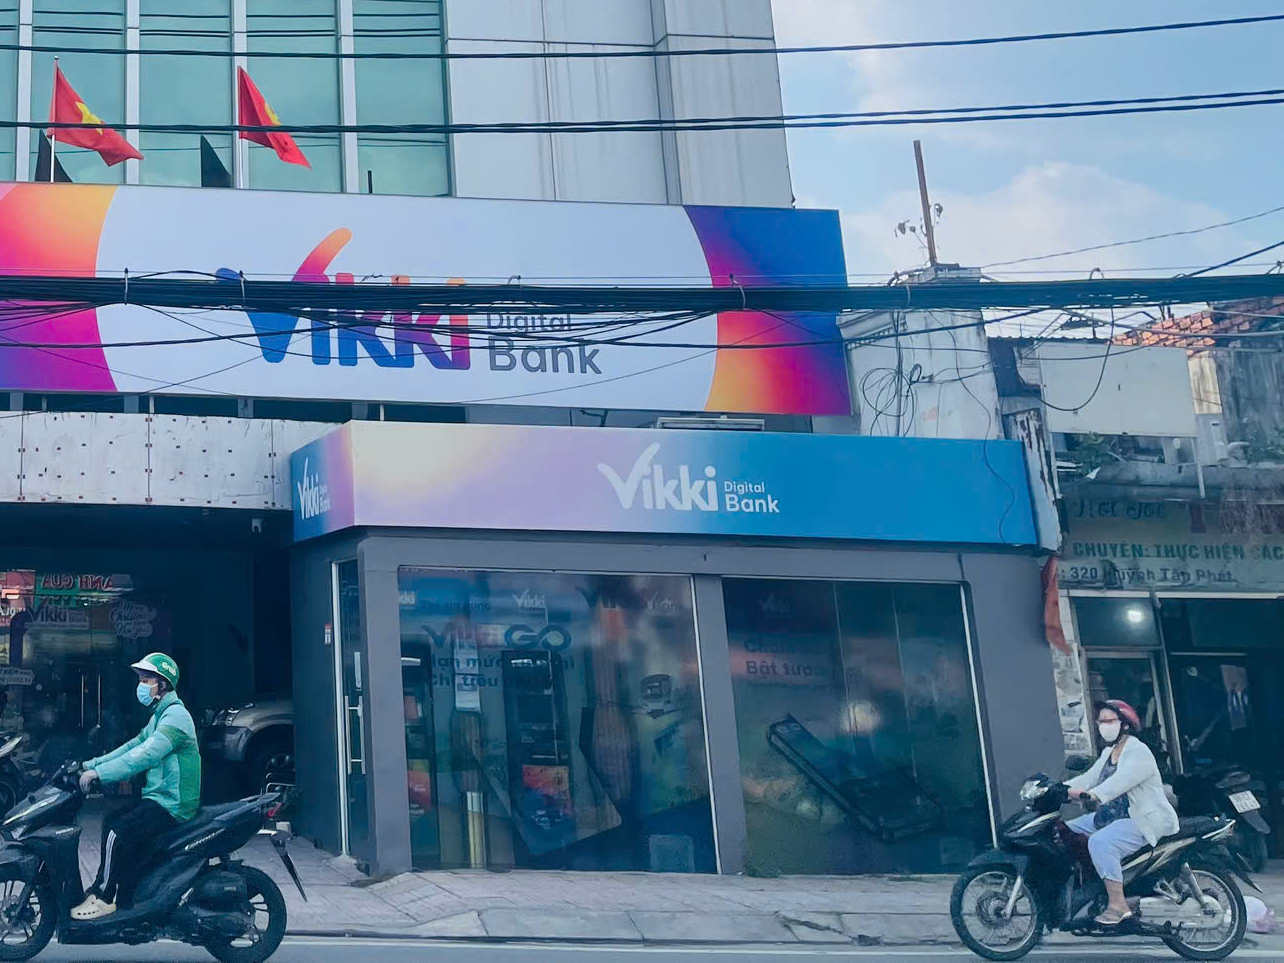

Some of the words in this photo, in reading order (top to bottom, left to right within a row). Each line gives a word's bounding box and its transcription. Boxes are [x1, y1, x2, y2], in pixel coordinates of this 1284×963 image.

[489, 336, 603, 375] Bank
[597, 442, 719, 512] Vikki
[724, 481, 765, 495] Digital
[725, 494, 780, 513] Bank
[1070, 566, 1098, 580] 320
